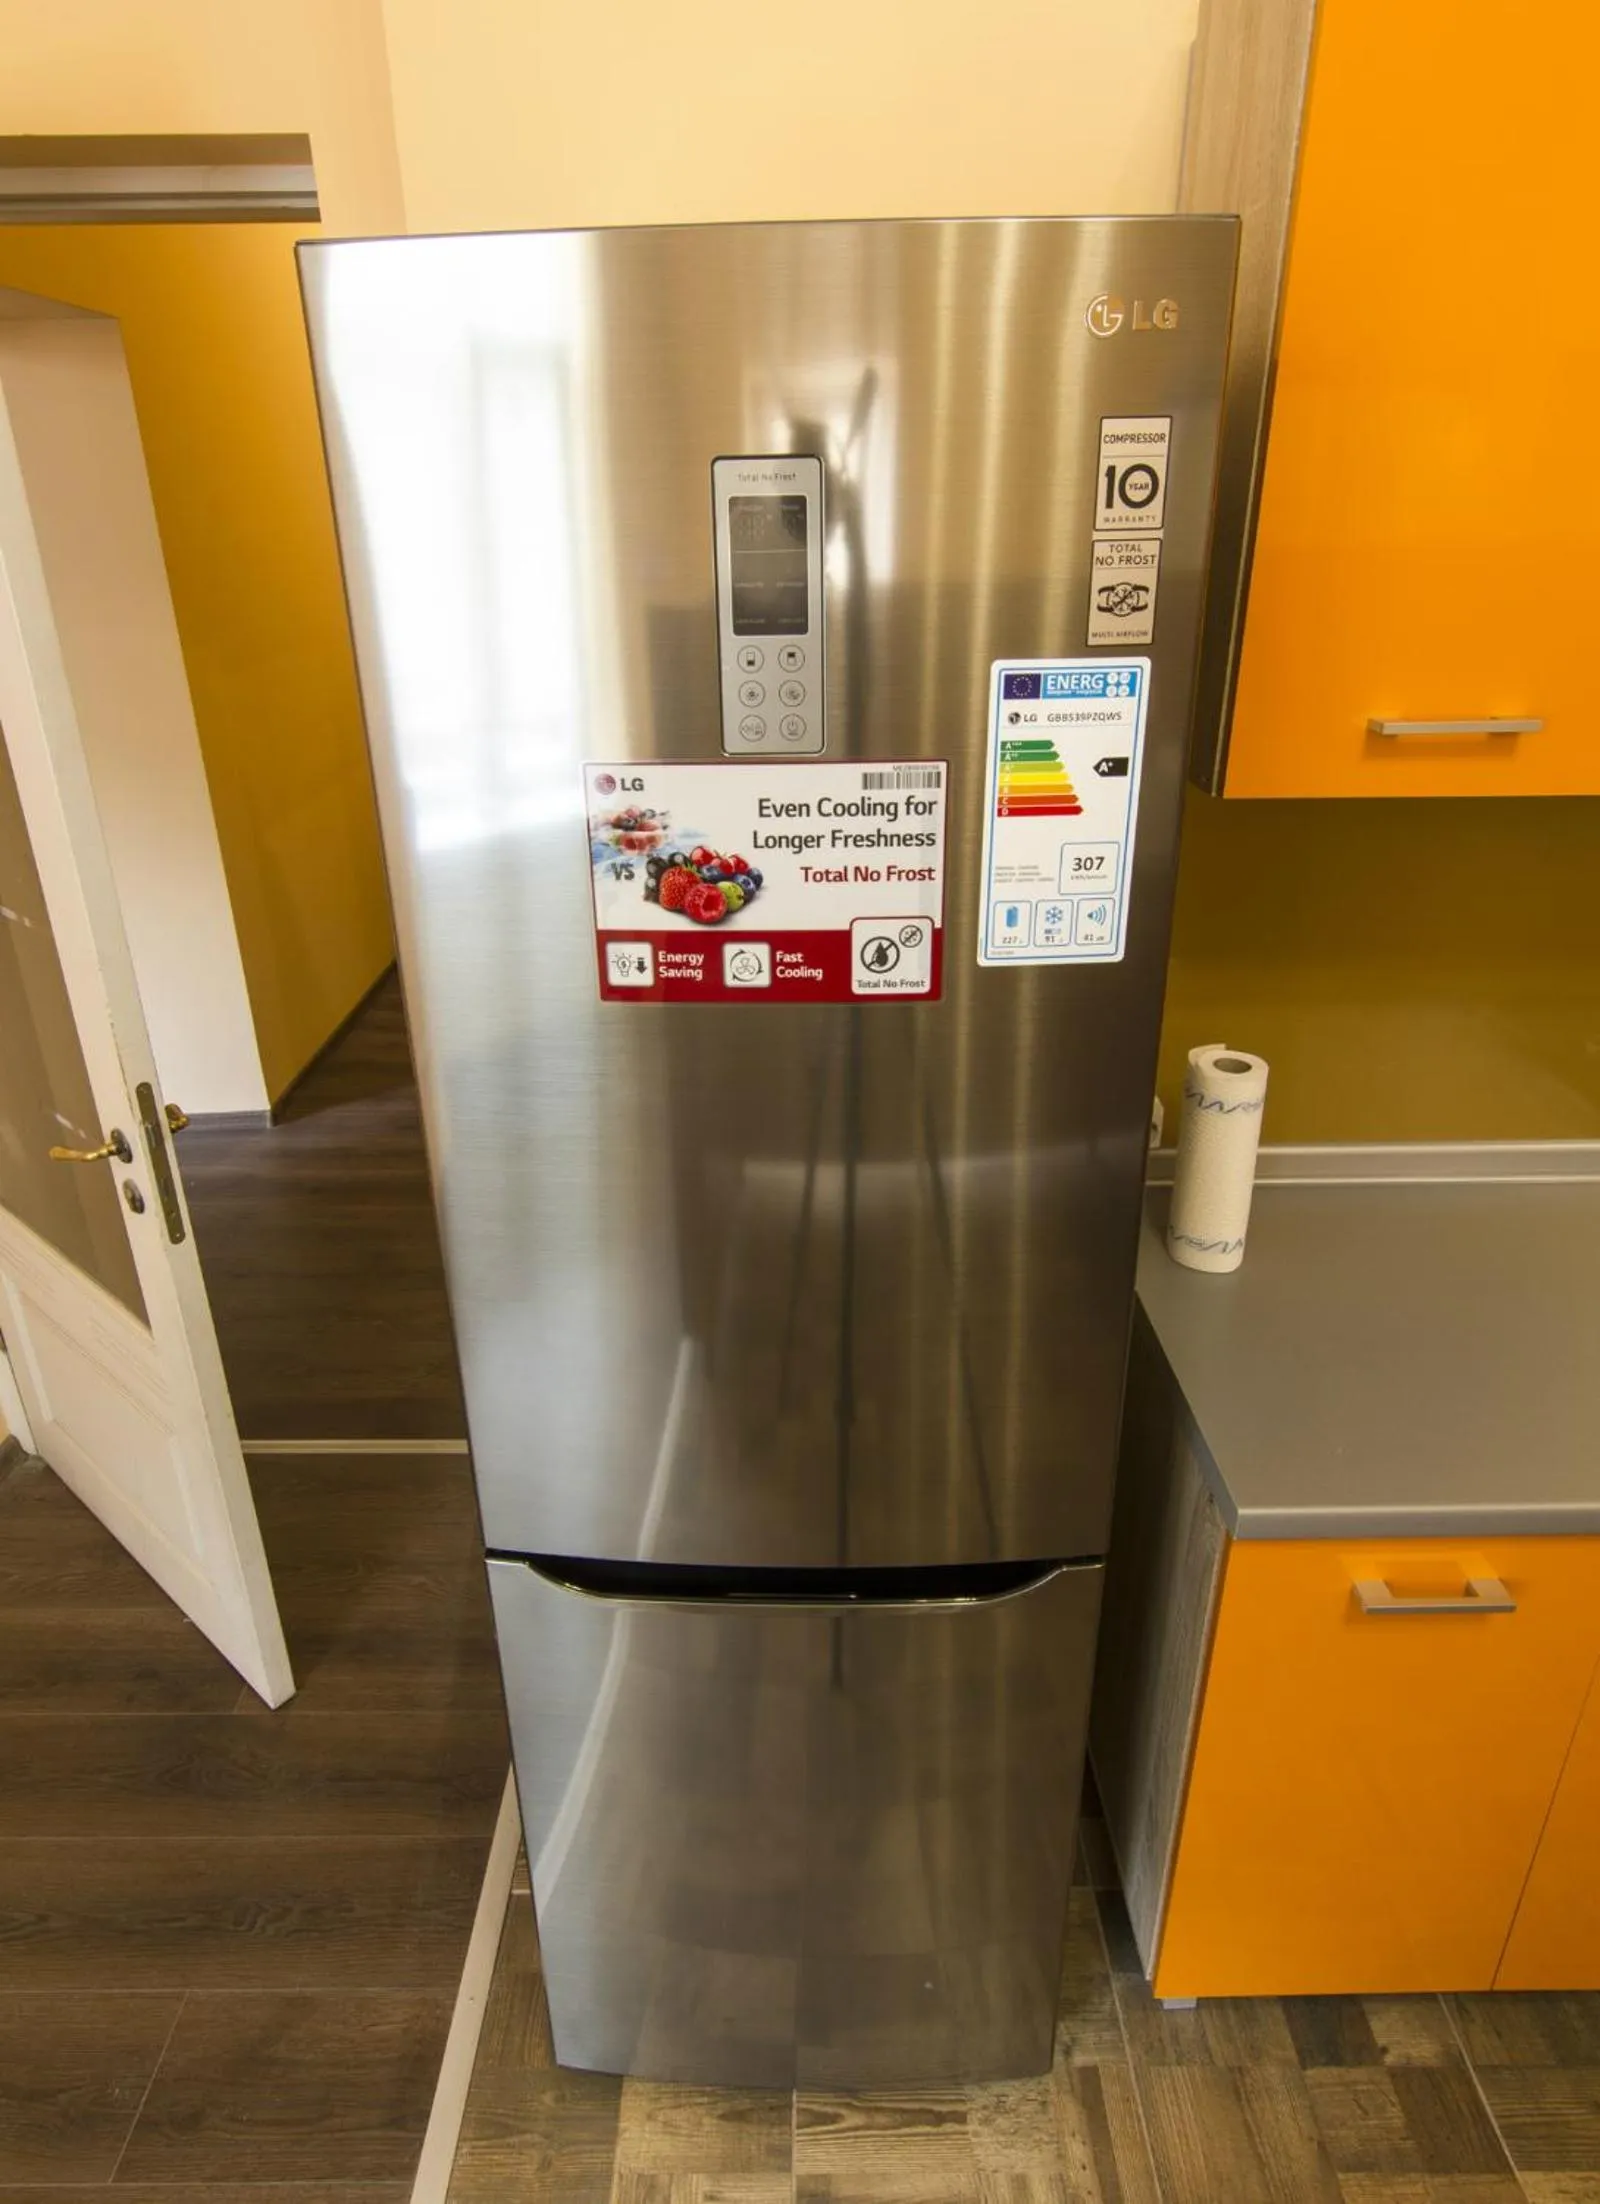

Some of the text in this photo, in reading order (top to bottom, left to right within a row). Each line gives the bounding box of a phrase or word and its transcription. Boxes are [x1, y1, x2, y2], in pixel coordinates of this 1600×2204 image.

[1132, 298, 1179, 331] LG
[1103, 432, 1168, 445] COMPRESSOR
[1104, 462, 1160, 510] 10
[1128, 482, 1150, 491] YEAR
[1109, 543, 1144, 554] TOTAL
[1095, 554, 1157, 567] NO FROST
[1046, 673, 1105, 691] ENERG
[1023, 713, 1038, 723] LG
[620, 777, 645, 792] LG
[758, 795, 938, 822] Even Cooling for
[752, 827, 937, 855] Longer Freshness
[611, 862, 636, 881] VS
[1072, 856, 1106, 872] 307
[800, 864, 936, 883] Total No Frost
[658, 950, 705, 966] Energy
[776, 951, 804, 963] Fast
[659, 966, 704, 981] Saving
[776, 966, 824, 981] Cooling
[857, 979, 927, 989] Total No Frost
